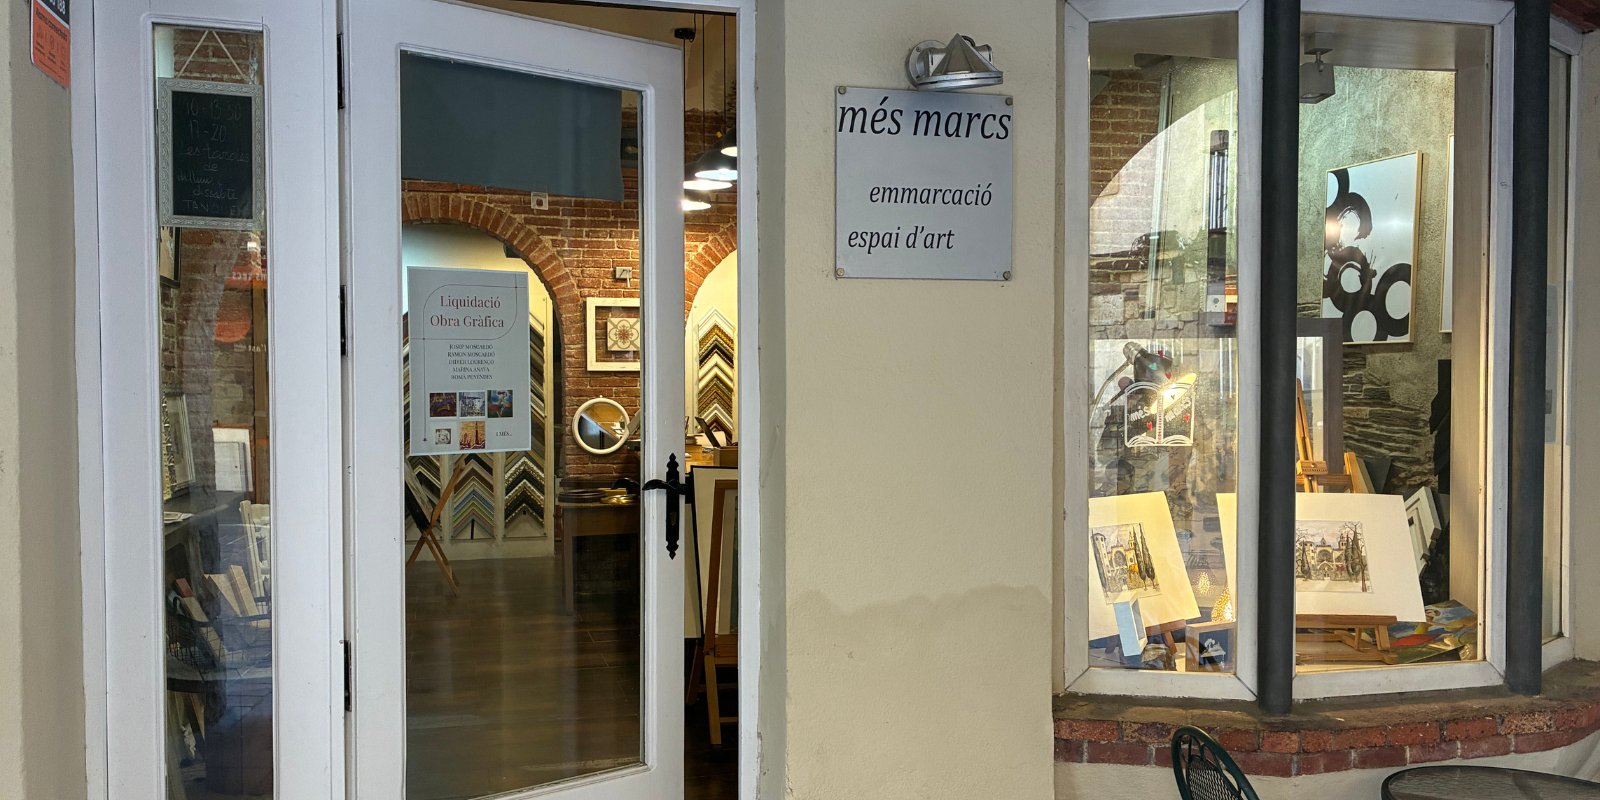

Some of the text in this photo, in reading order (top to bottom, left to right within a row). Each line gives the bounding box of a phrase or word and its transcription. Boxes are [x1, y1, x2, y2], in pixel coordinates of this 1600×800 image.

[838, 96, 1012, 140] més marcs
[203, 162, 219, 172] de
[870, 183, 992, 206] emmarcació
[848, 226, 955, 254] espai d’art
[440, 295, 501, 310] Liquidació
[430, 314, 504, 328] Obra Gràfica
[1130, 405, 1150, 422] més
